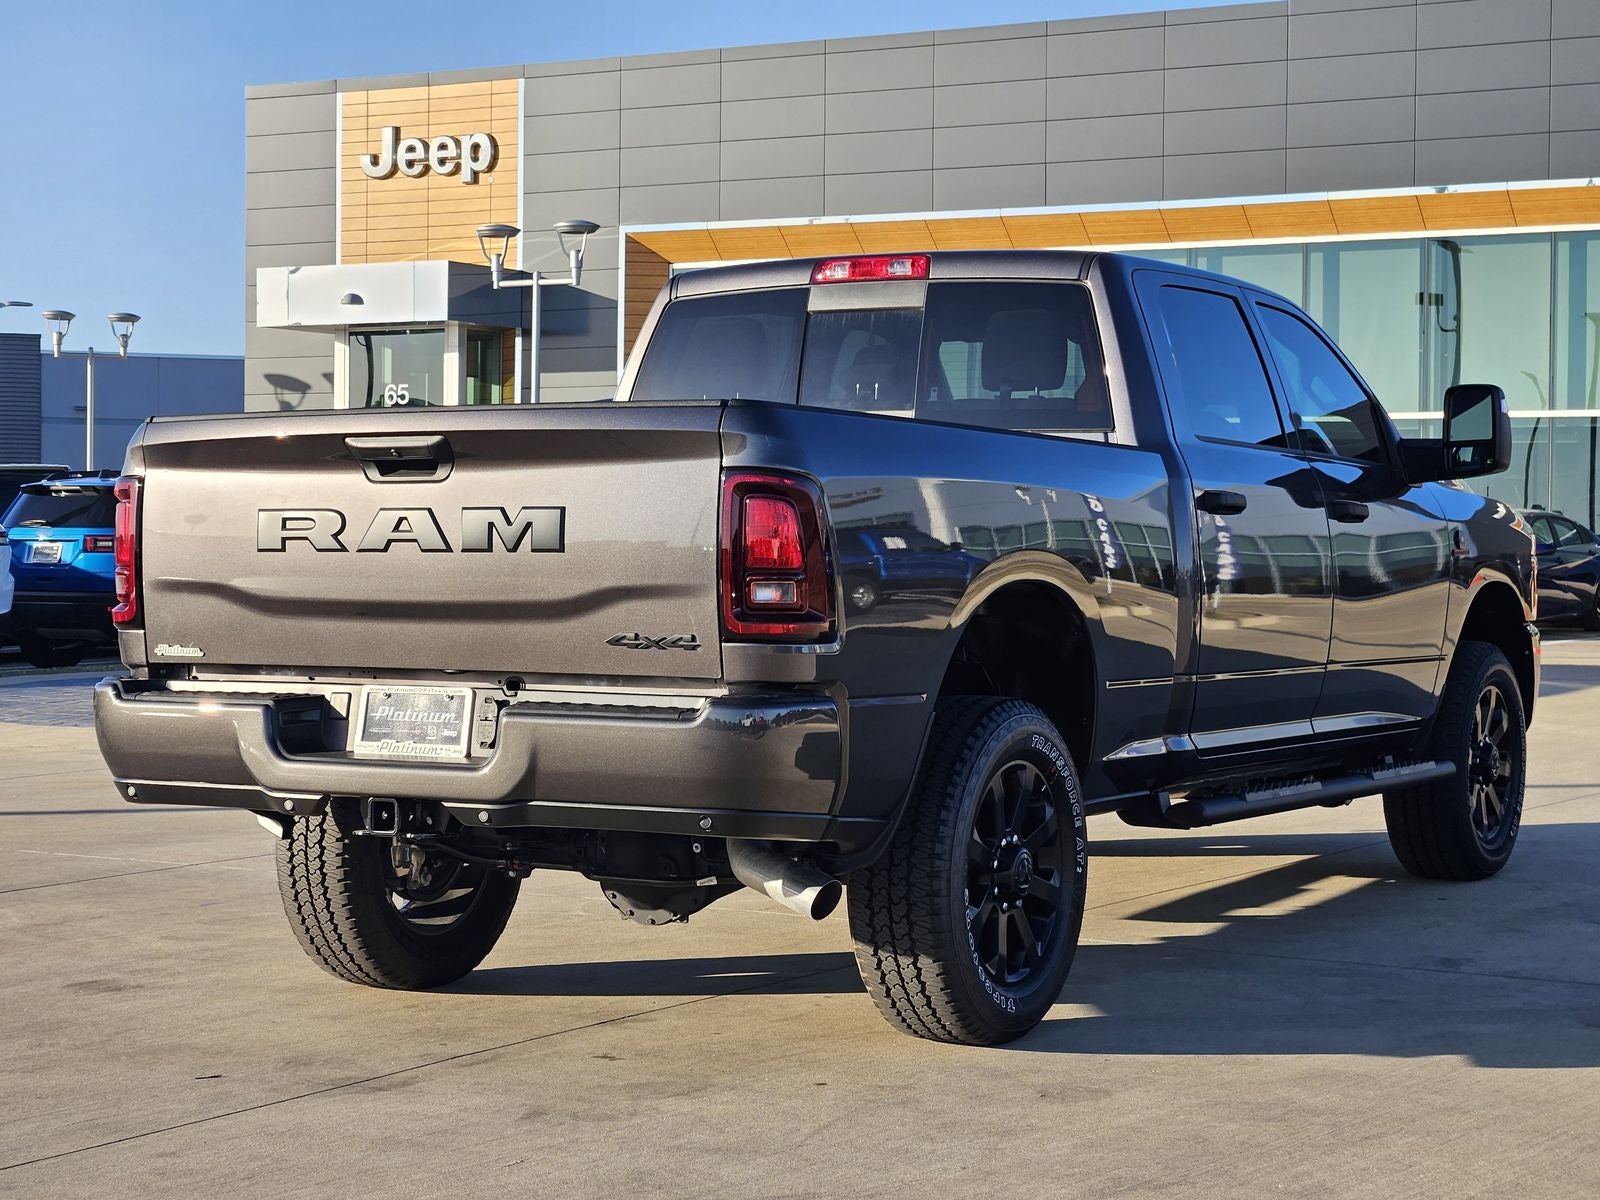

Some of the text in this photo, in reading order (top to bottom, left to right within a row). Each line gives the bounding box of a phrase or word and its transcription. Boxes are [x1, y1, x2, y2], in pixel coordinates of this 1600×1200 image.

[360, 126, 499, 184] Jeep
[384, 383, 410, 405] 65
[257, 506, 566, 553] RAM
[155, 644, 205, 656] Platinum
[370, 706, 459, 723] Platinum
[442, 728, 458, 738] Jeep
[380, 741, 442, 755] Platinum
[1031, 734, 1083, 829] TRANSFORCE
